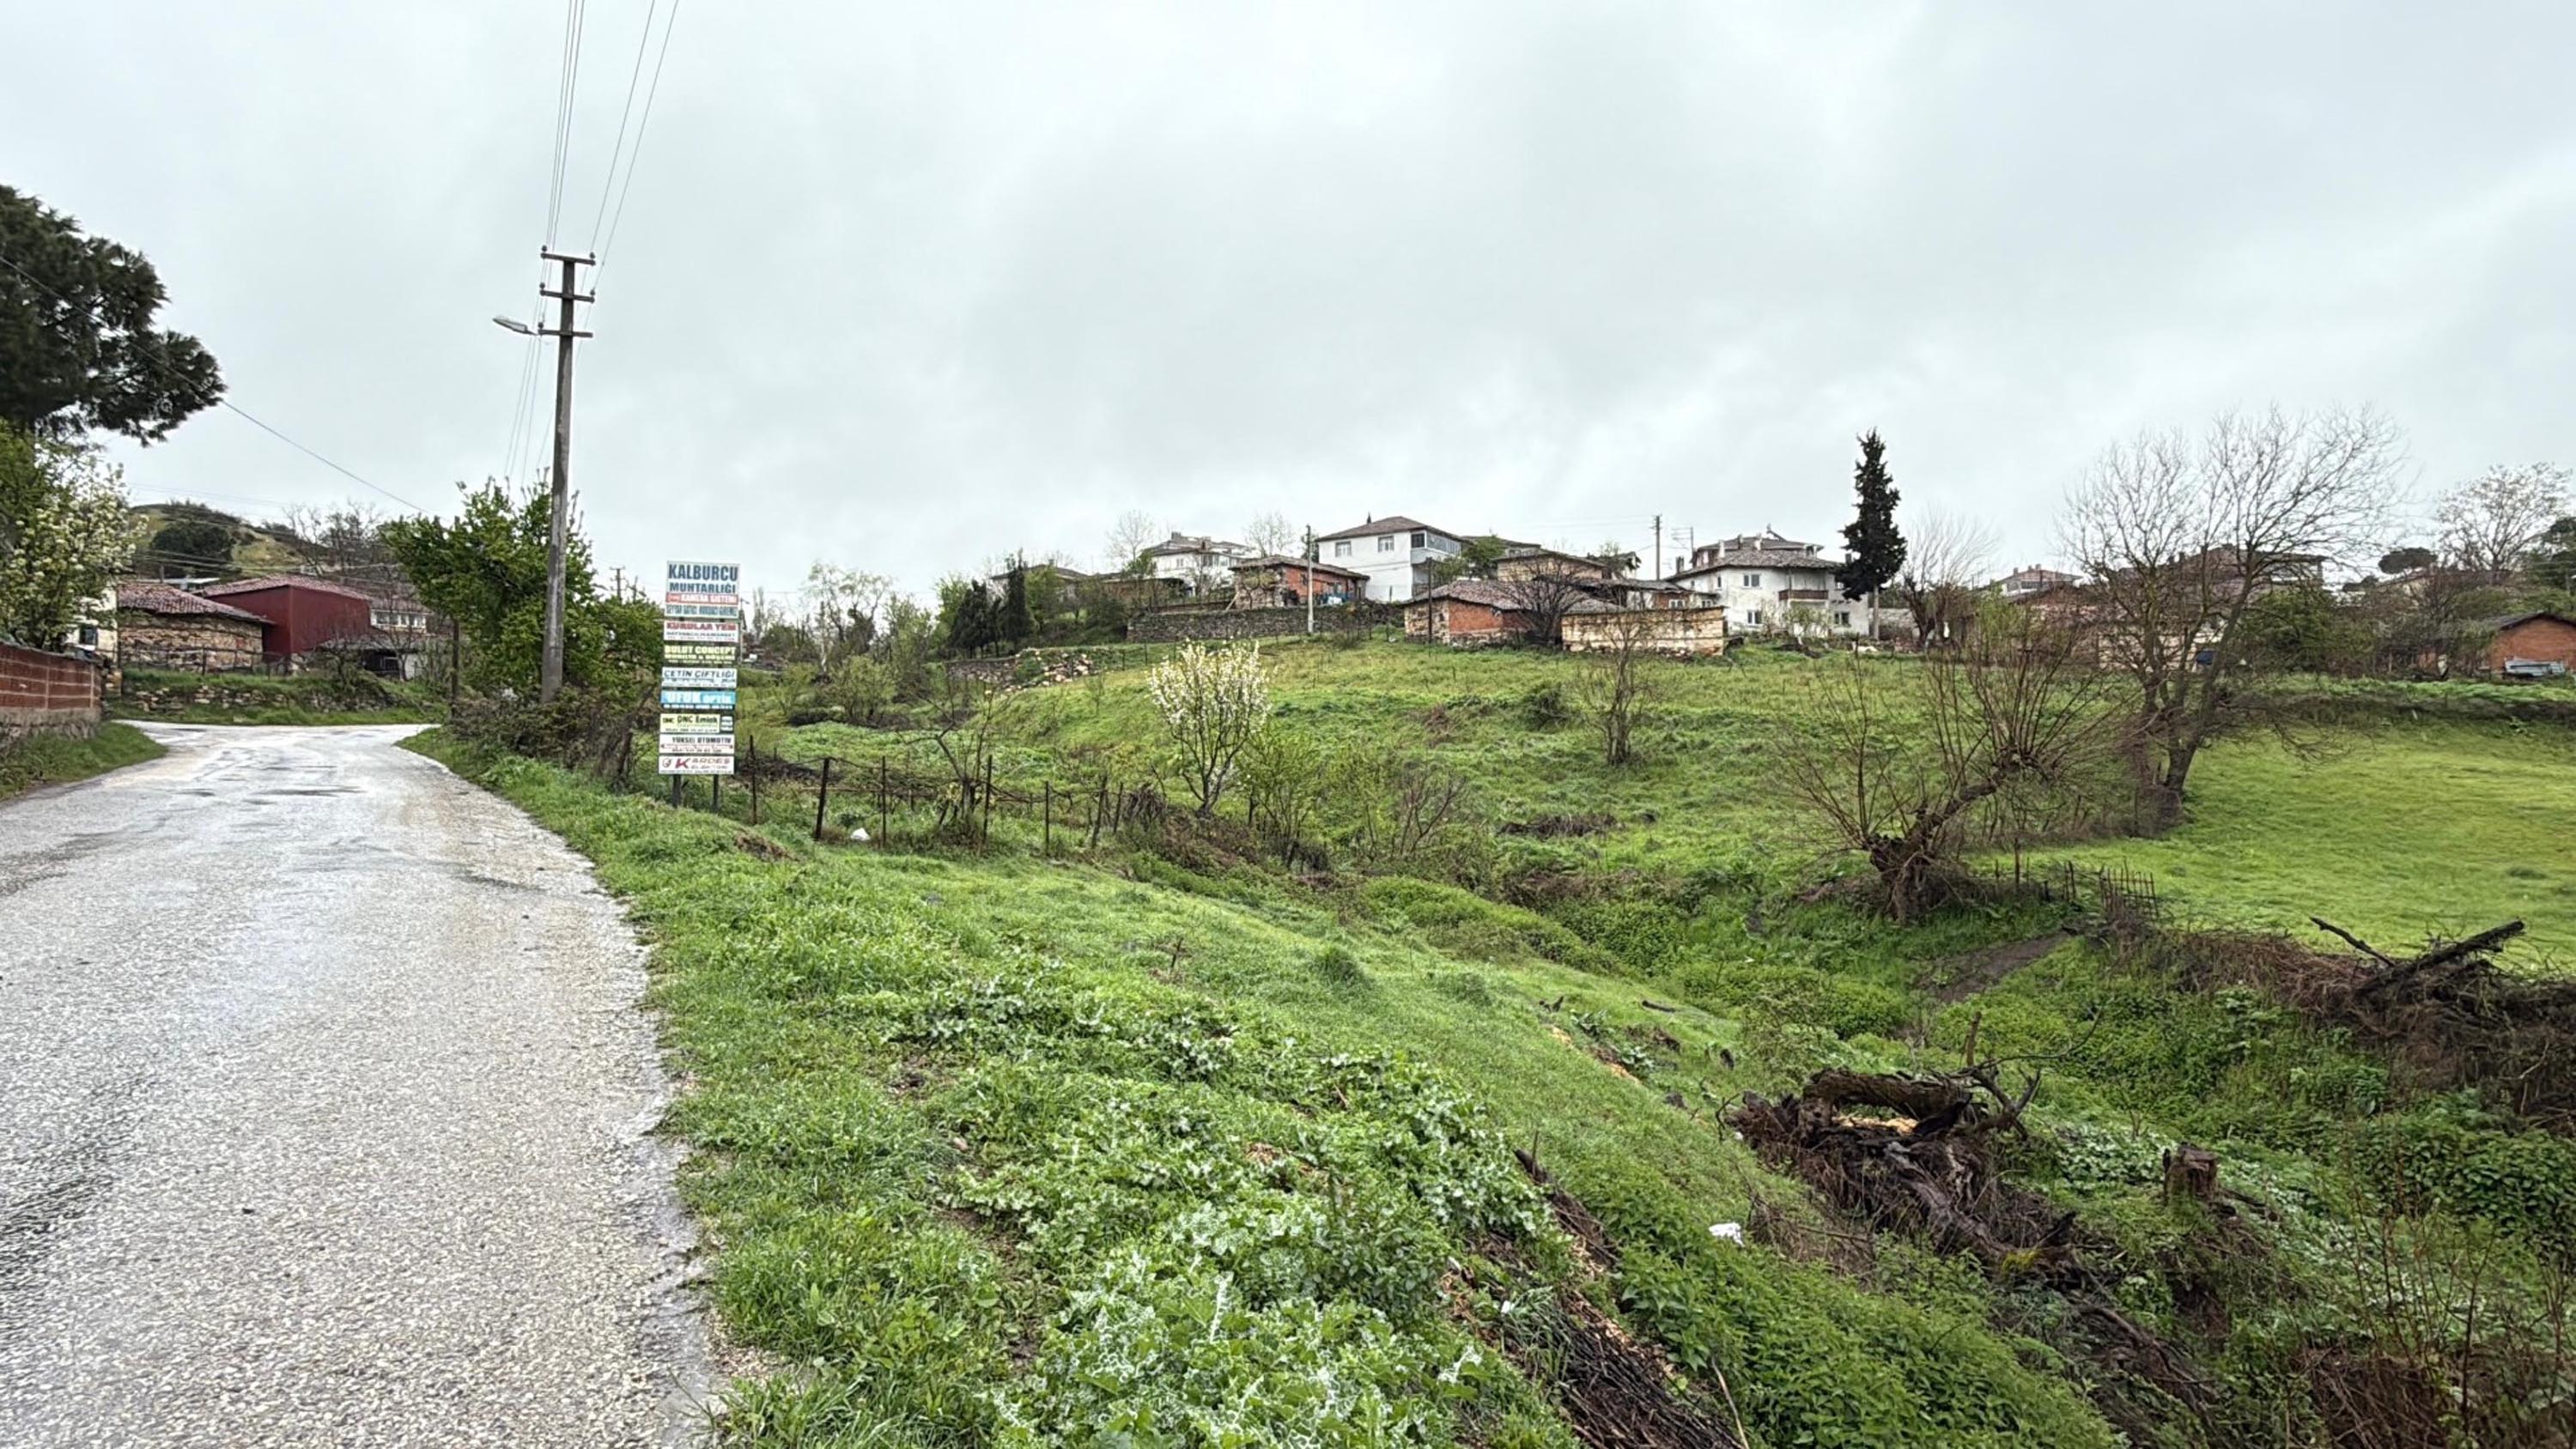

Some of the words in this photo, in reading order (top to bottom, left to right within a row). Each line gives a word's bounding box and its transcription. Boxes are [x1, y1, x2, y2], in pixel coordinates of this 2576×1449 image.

[668, 564, 738, 581] KALBURCU
[670, 582, 736, 594] MUHTARLIĞI
[695, 646, 736, 655] CONCEPT
[695, 670, 735, 679] ÇİFTLİĞİ
[677, 715, 694, 724] DNC
